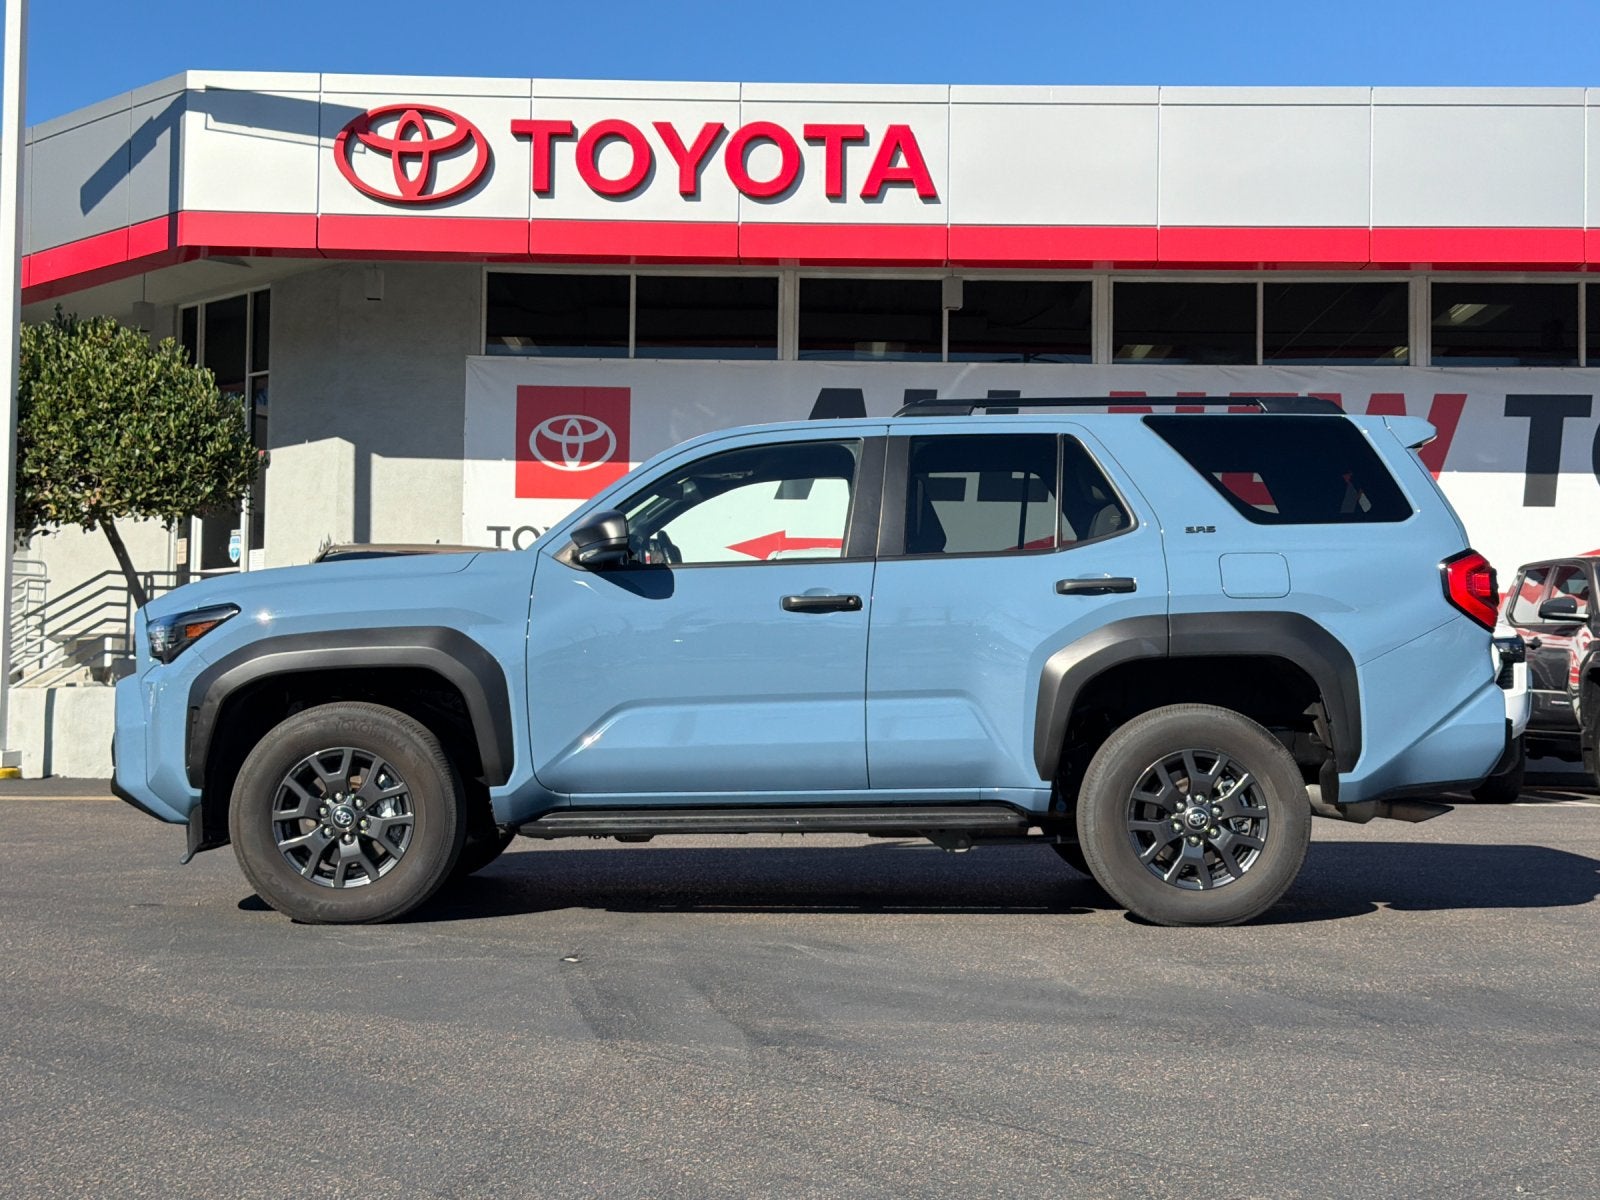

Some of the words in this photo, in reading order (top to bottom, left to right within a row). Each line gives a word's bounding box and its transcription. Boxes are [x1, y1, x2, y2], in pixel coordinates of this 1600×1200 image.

[511, 118, 938, 202] TOYOTA
[1503, 394, 1600, 508] T
[486, 525, 550, 551] TO
[1185, 525, 1216, 534] SR5
